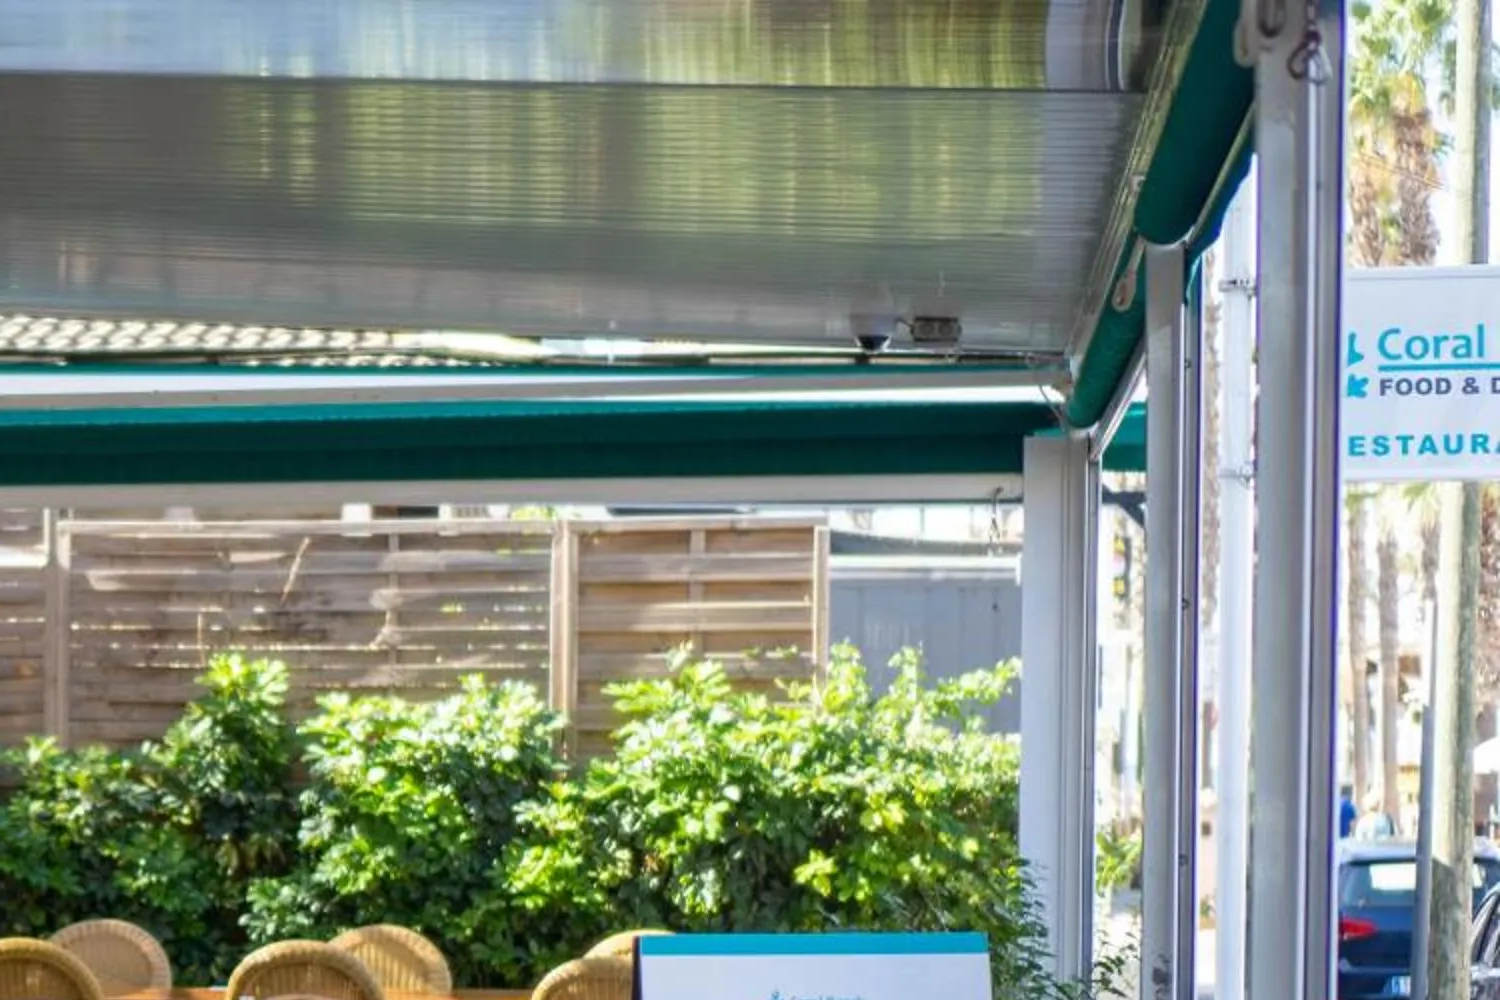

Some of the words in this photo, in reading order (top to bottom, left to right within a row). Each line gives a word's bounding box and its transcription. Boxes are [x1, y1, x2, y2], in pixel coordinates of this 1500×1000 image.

[1378, 323, 1485, 361] Coral
[1379, 377, 1452, 396] FOOD
[1461, 376, 1480, 394] &
[1347, 433, 1500, 457] ESTAUR
